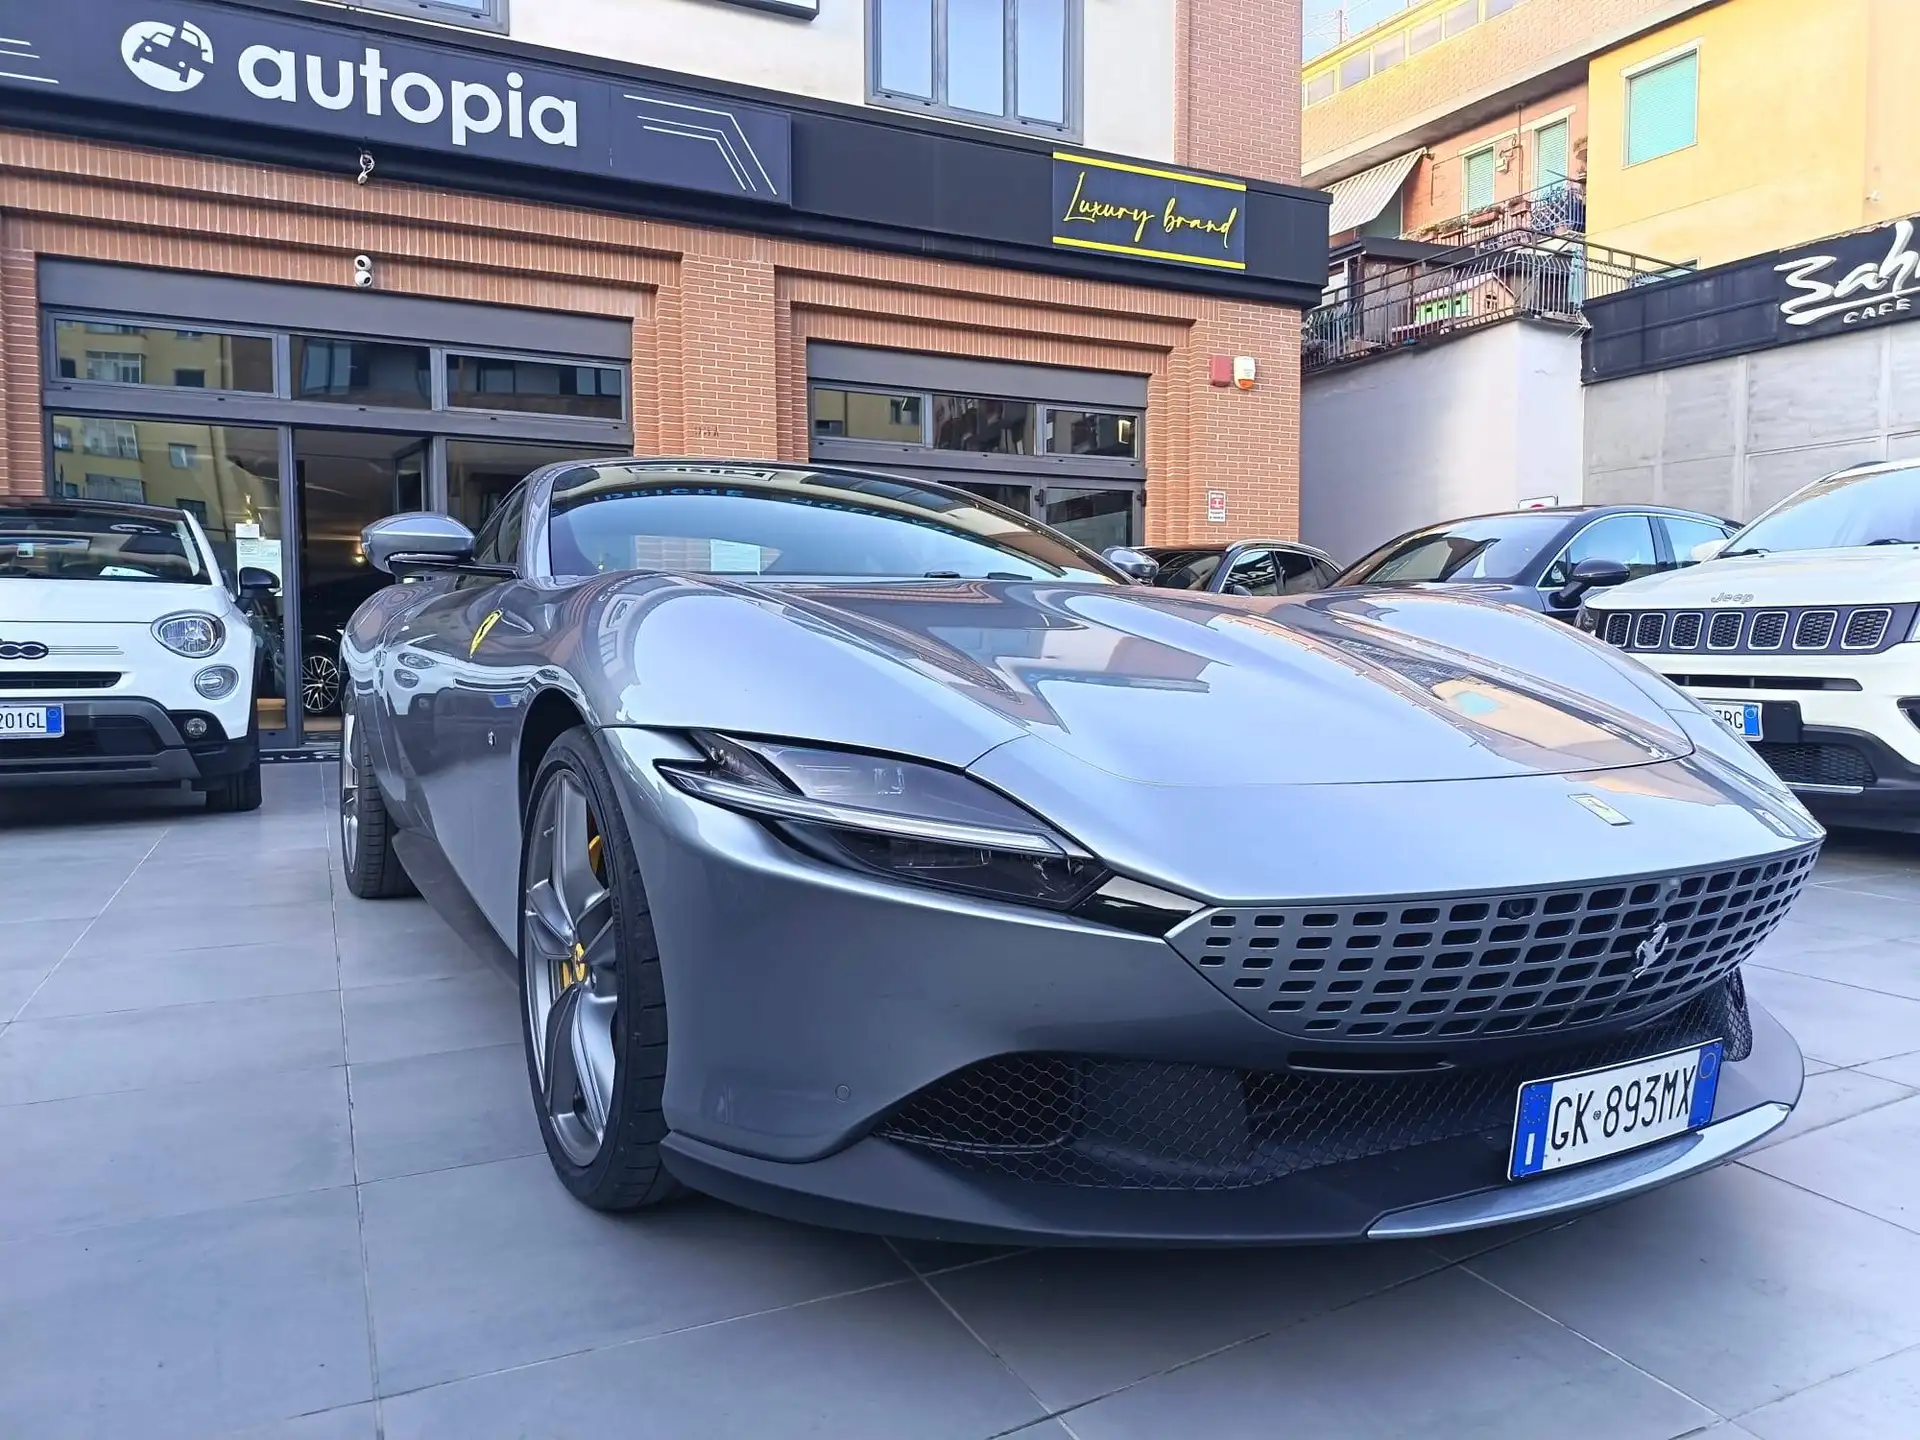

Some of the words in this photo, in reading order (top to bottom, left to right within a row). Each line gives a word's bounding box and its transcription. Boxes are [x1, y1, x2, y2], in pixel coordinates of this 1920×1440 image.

[238, 44, 578, 148] autopia
[1063, 171, 1155, 243] Luxury
[1163, 198, 1238, 249] brand
[1773, 219, 1920, 325] Zah
[1843, 298, 1912, 324] CAFE
[1710, 592, 1755, 605] Jeep
